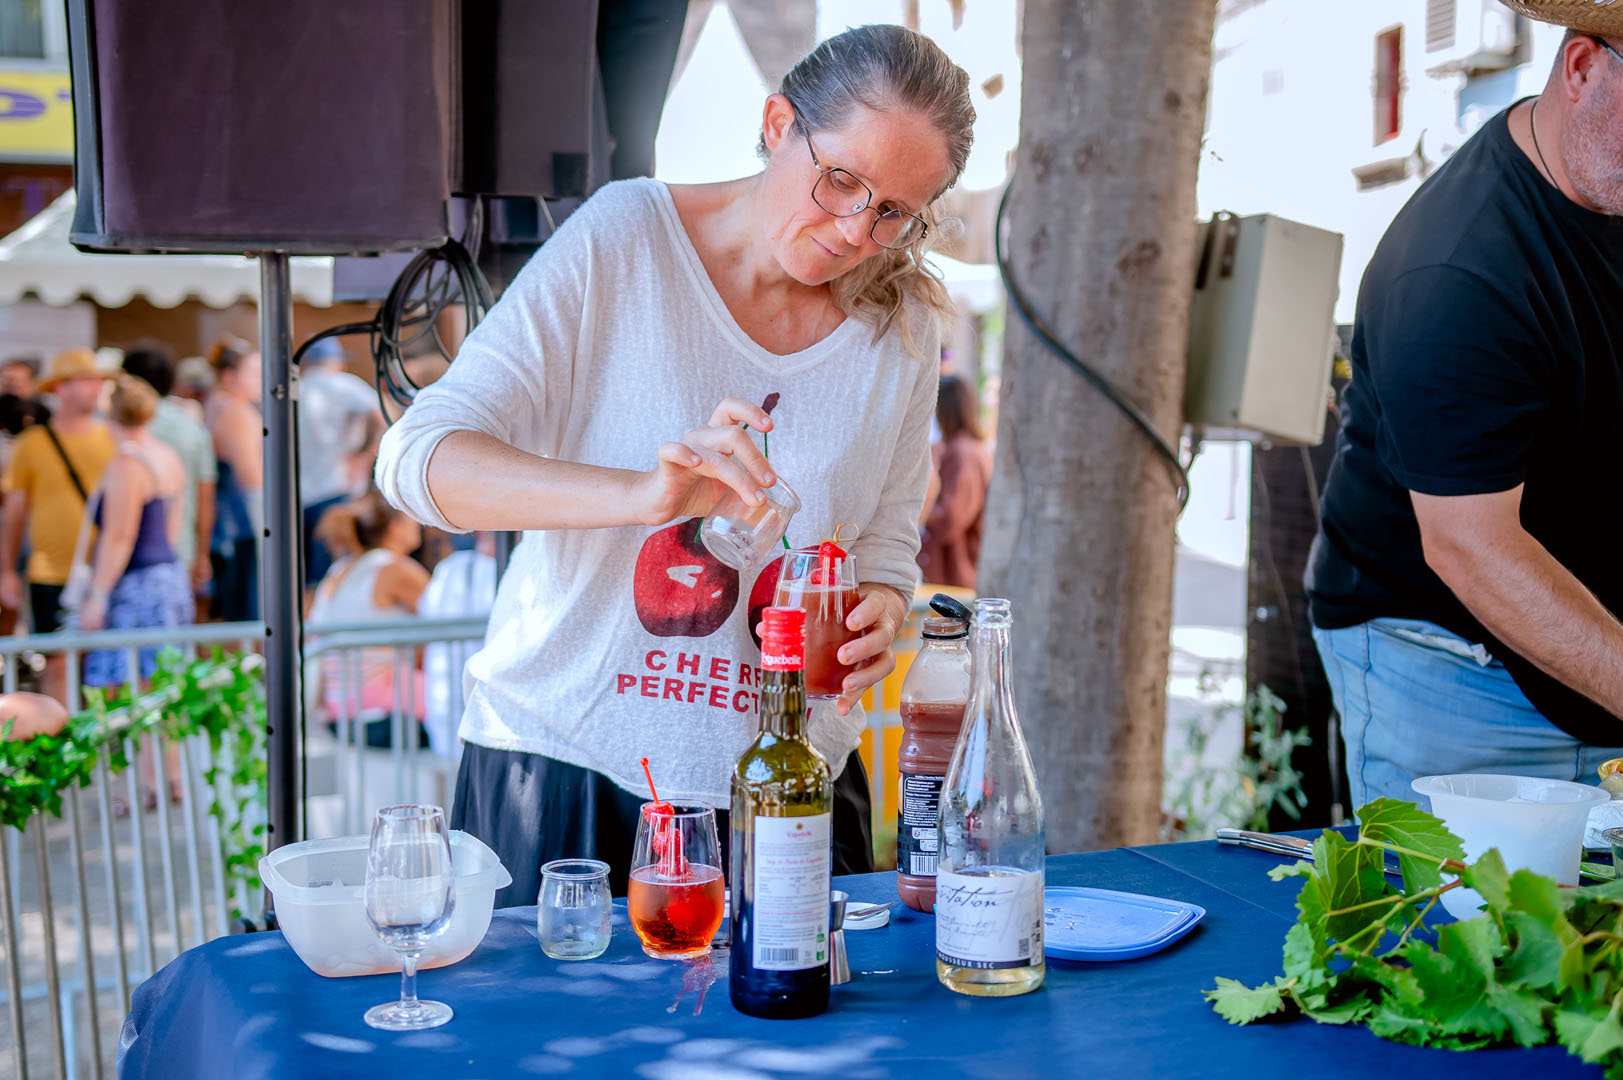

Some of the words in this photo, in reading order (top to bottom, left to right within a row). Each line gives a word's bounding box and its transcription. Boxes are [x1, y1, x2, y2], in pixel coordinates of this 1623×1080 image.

[645, 649, 762, 689] CHERR
[617, 673, 812, 724] PERFECT
[977, 961, 995, 969] SEC
